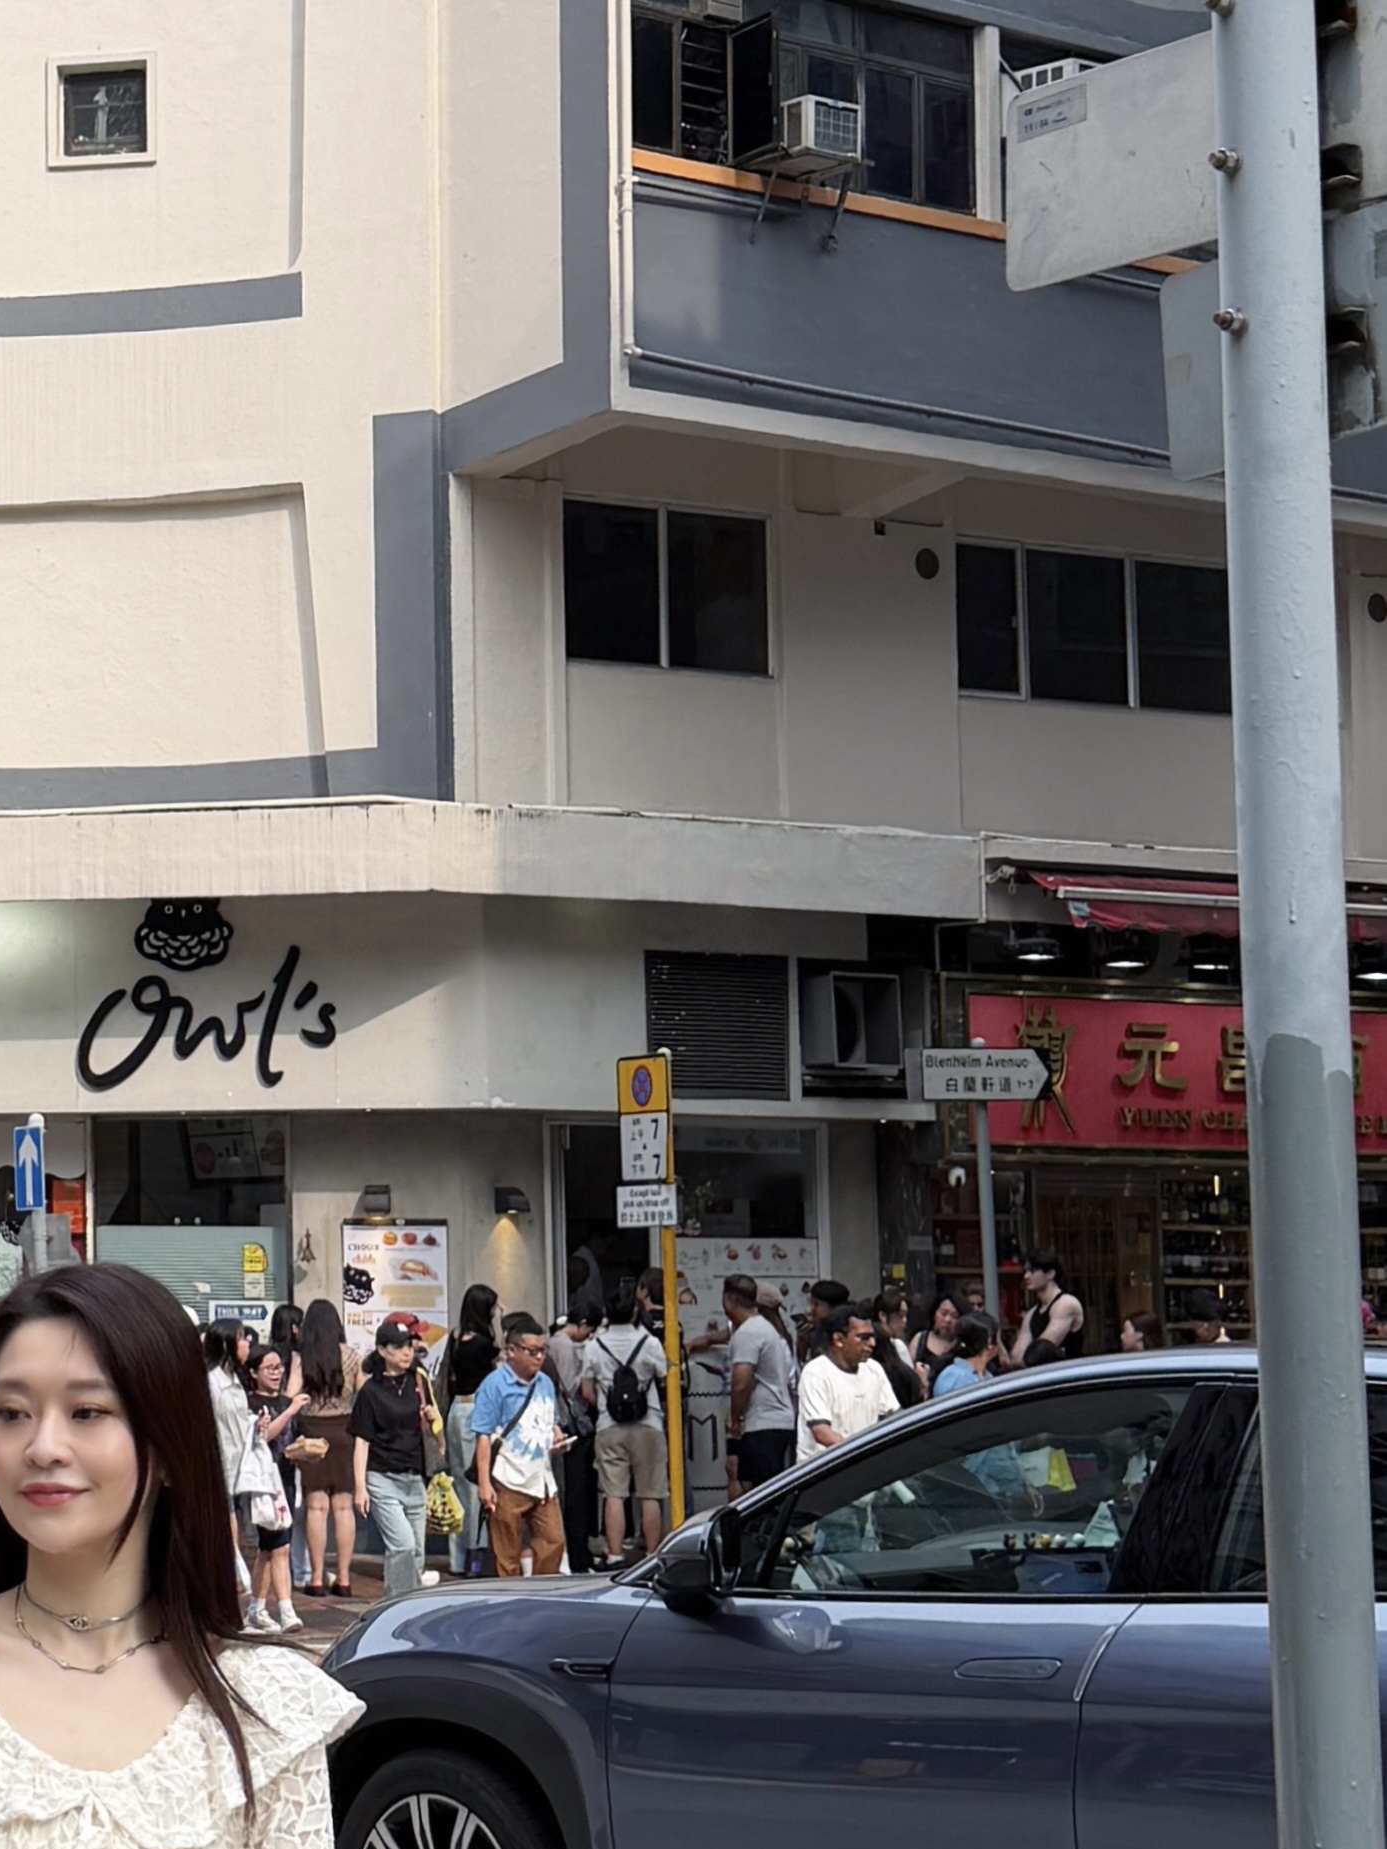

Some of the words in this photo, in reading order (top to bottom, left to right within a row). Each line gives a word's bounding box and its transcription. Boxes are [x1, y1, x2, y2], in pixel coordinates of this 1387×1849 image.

[76, 944, 337, 1092] Owl's
[925, 1055, 981, 1068] Blenheim
[986, 1055, 1028, 1068] Avenue
[650, 1118, 659, 1140] 7
[652, 1154, 661, 1176] 7
